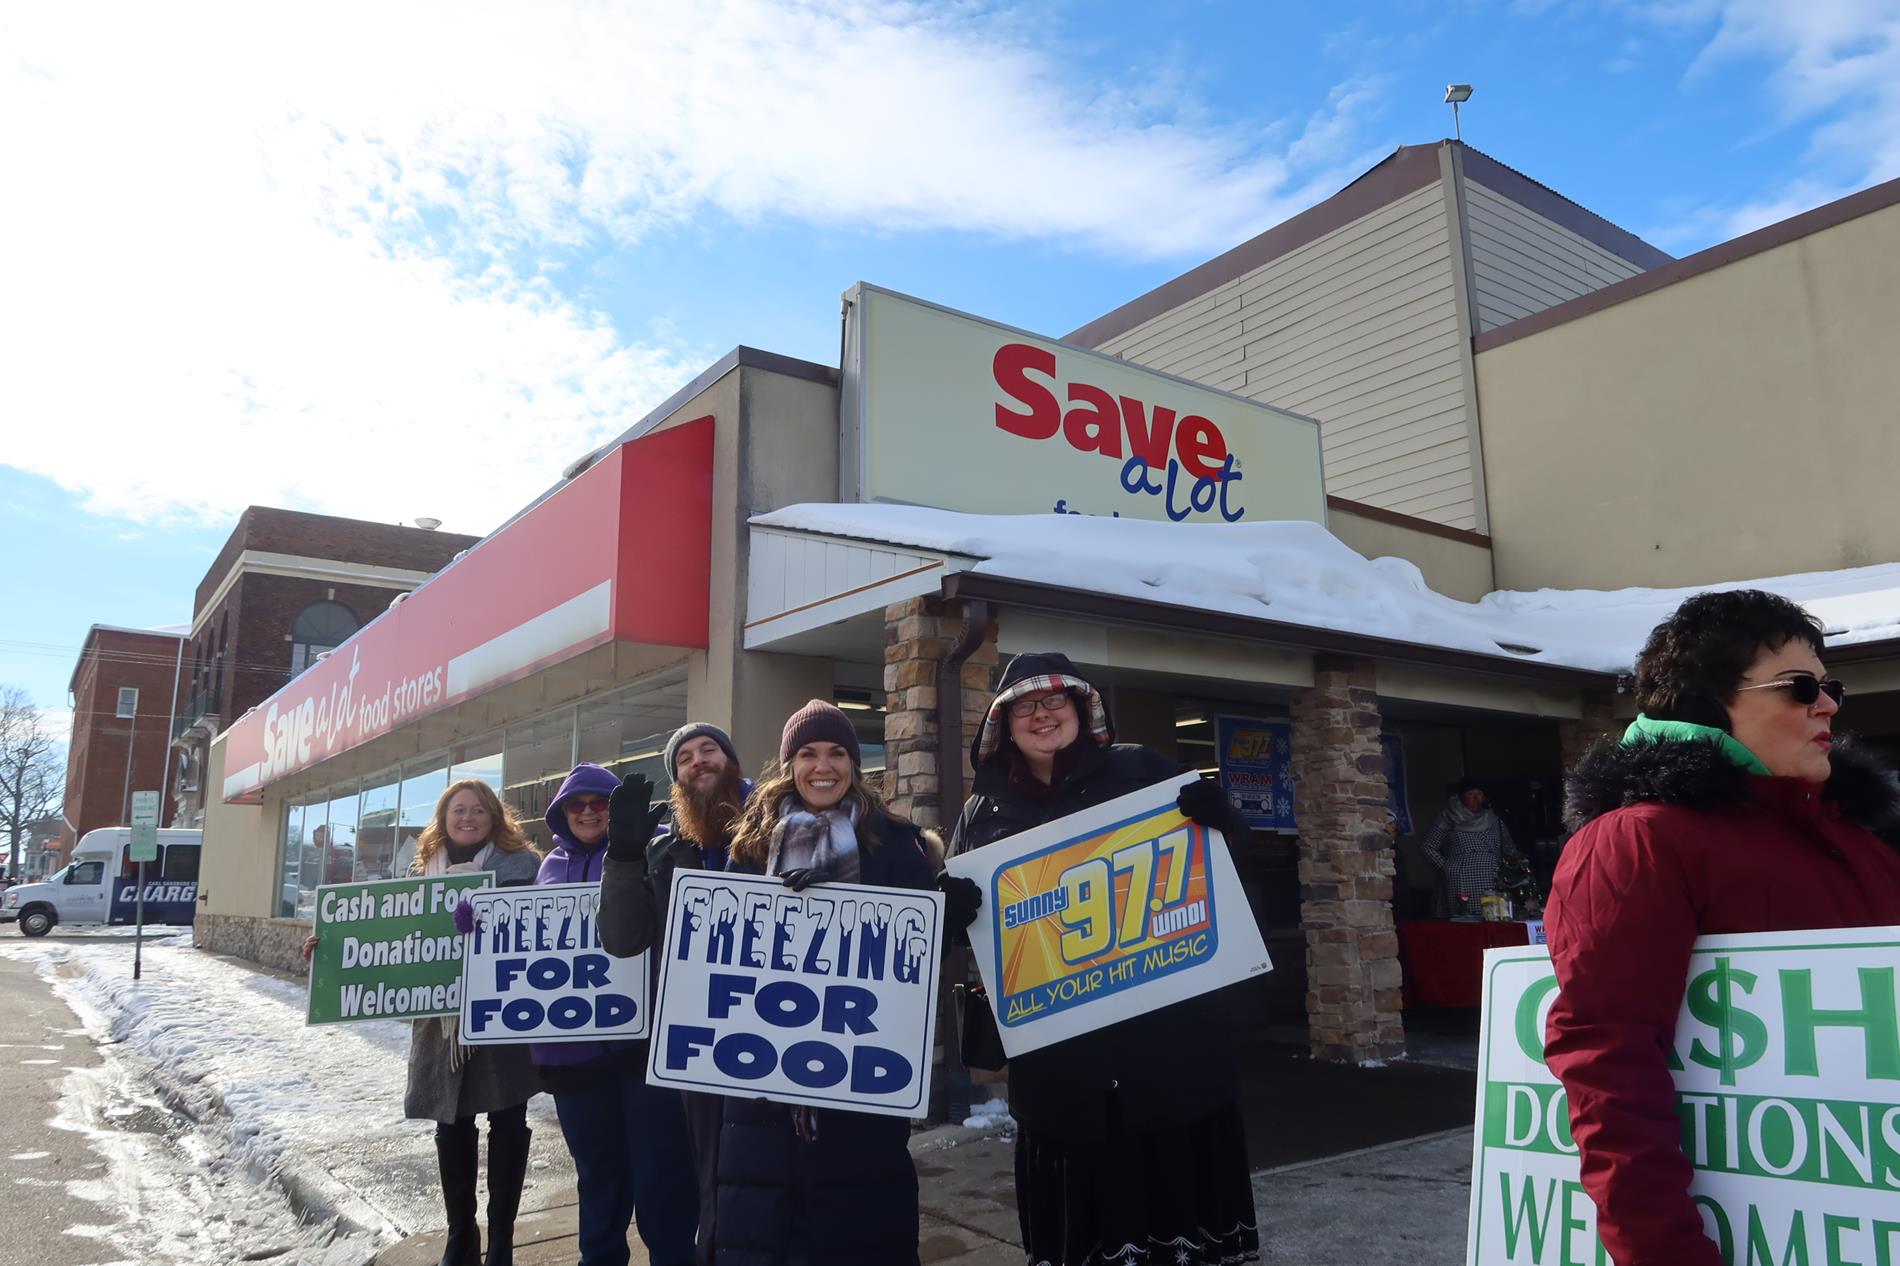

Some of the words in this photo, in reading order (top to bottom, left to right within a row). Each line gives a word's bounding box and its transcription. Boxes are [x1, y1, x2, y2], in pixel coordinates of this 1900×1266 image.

[992, 343, 1228, 482] Save
[1120, 455, 1162, 495] a
[260, 697, 314, 779] Save
[315, 697, 329, 739] a
[358, 681, 391, 737] food
[393, 665, 442, 720] stores
[1229, 772, 1272, 785] WRAM
[119, 885, 198, 902] CHARG
[321, 887, 375, 923] Cash
[380, 884, 425, 918] and
[474, 893, 602, 954] FREEZI
[1060, 826, 1192, 965] 97.7
[341, 930, 463, 968] Donations
[677, 887, 927, 984] FREEZING
[340, 976, 461, 1017] Welcomed
[495, 953, 611, 992] FOR
[1007, 998, 1046, 1021] ALL
[1047, 970, 1103, 1005] YOUR
[1109, 958, 1137, 985] HIT
[1143, 934, 1208, 973] MUSIC
[471, 994, 637, 1032] FOOD
[708, 973, 878, 1036] FOR
[1515, 957, 1900, 1087] C$H
[666, 1024, 913, 1094] FOOD
[1505, 1085, 1900, 1189] DOTIONS
